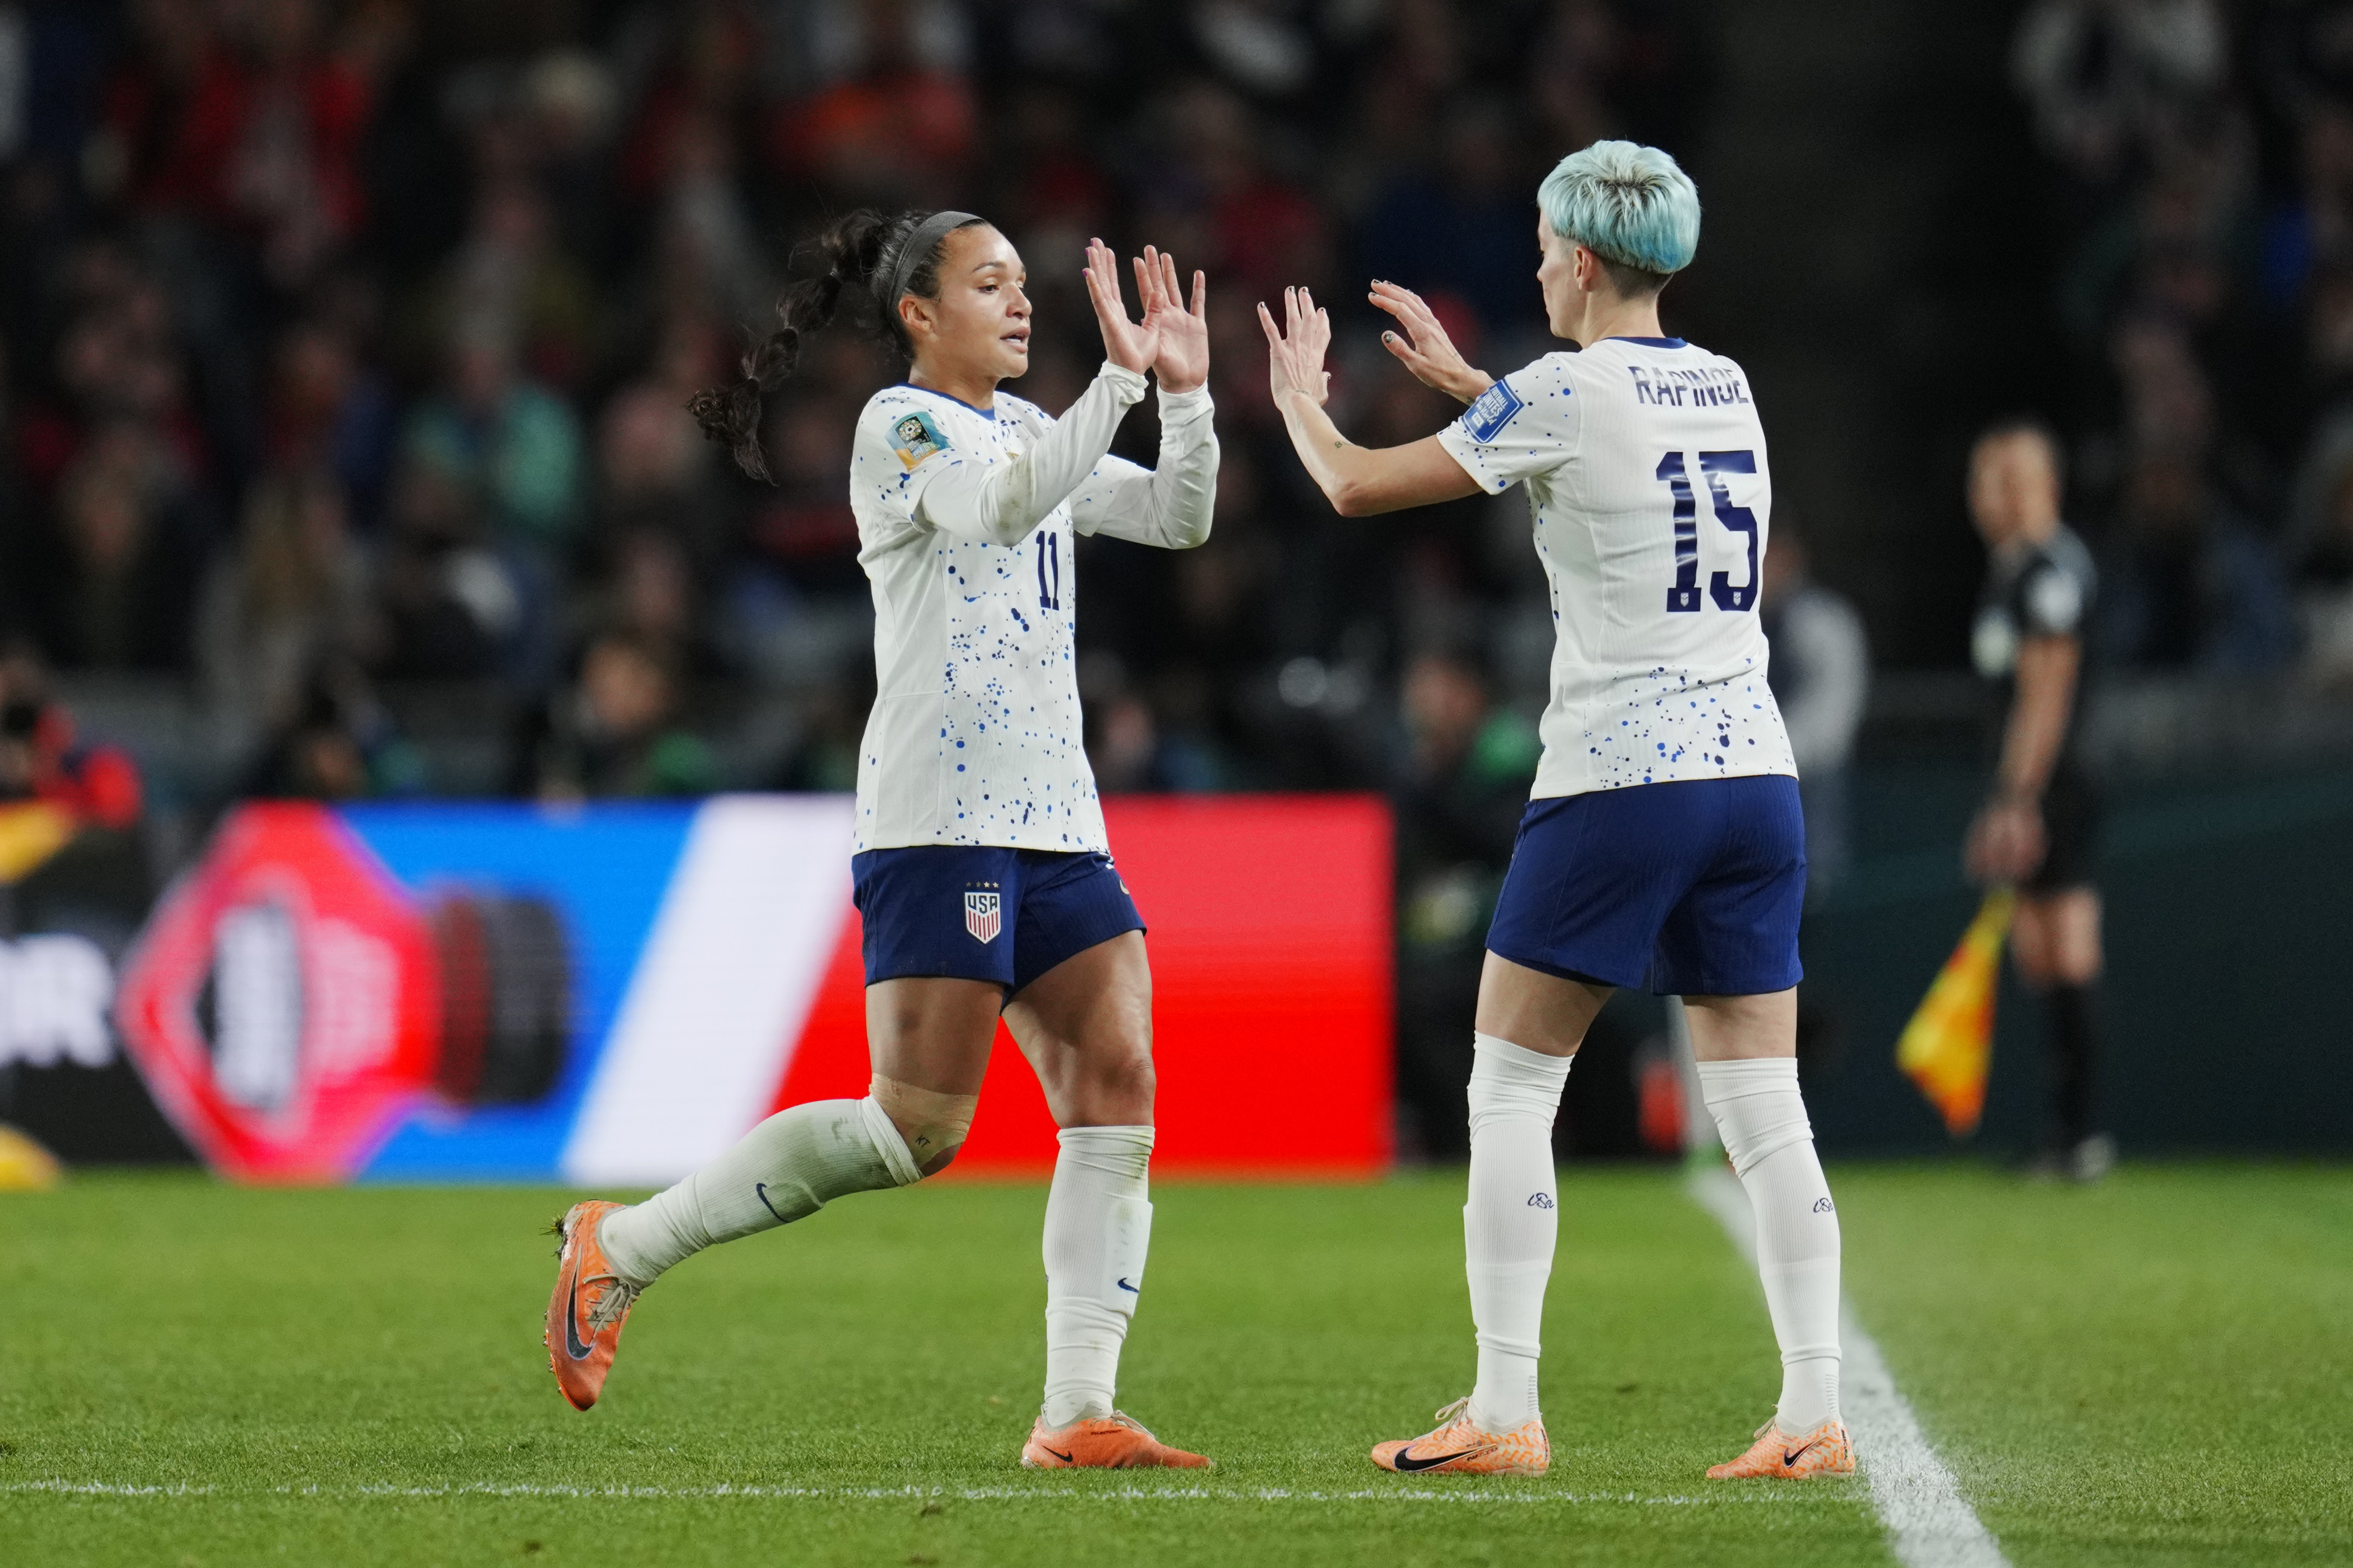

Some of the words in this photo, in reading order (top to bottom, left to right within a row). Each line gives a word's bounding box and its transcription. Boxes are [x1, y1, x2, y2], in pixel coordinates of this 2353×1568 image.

[1490, 386, 1508, 409] FOOTBALL
[1627, 366, 1750, 407] RAPINOE
[1480, 406, 1497, 426] World
[1483, 394, 1503, 416] UNITES
[1656, 449, 1758, 612] 15
[1036, 530, 1060, 611] 11
[967, 895, 998, 915] USA
[915, 1134, 931, 1148] KT
